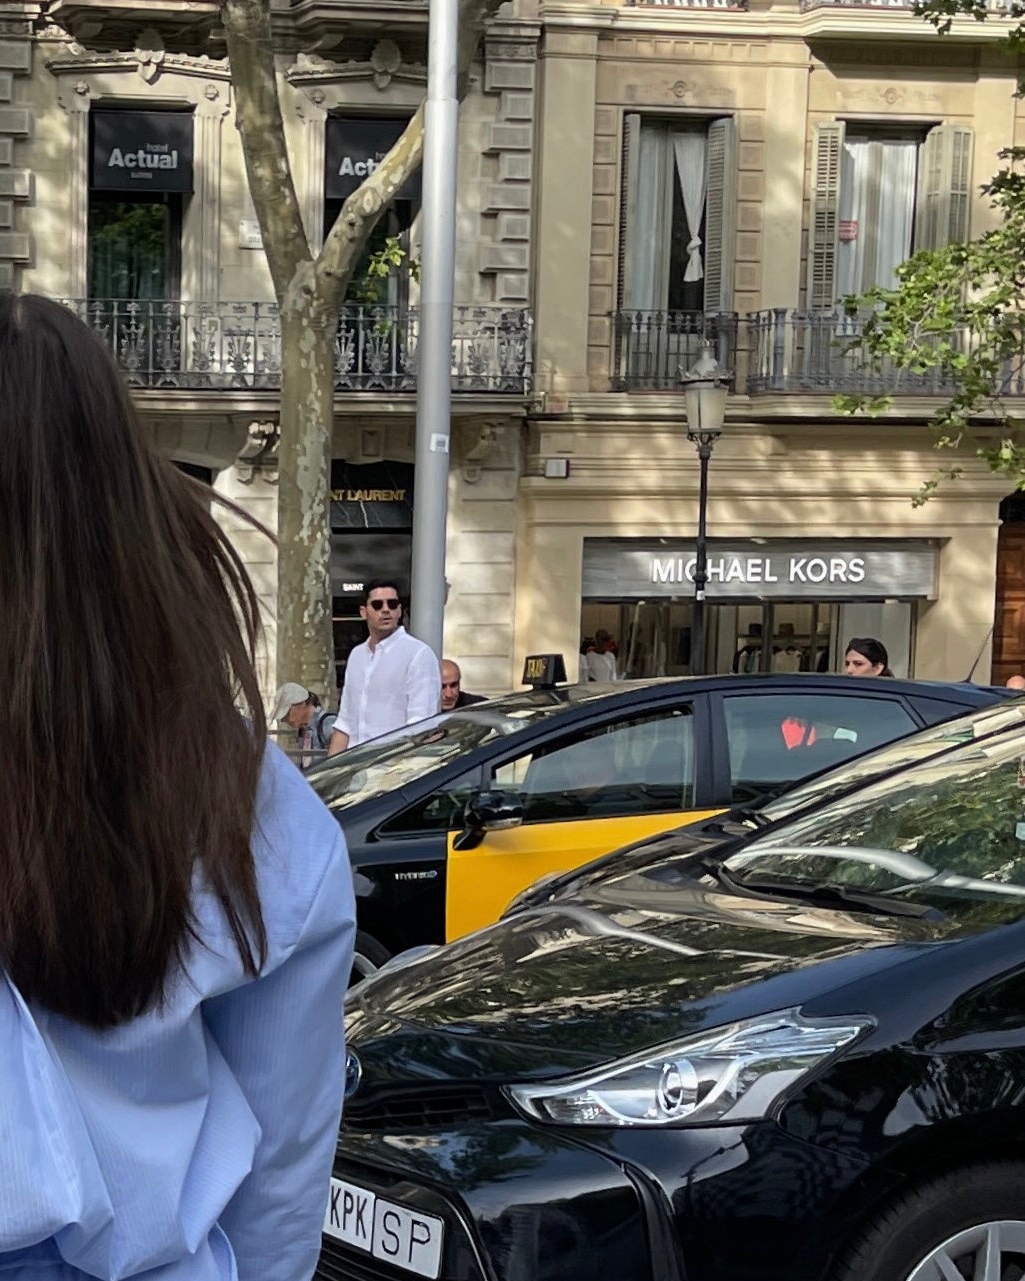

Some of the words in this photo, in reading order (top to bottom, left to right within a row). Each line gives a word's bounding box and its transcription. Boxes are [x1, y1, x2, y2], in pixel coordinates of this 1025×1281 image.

[108, 147, 178, 169] Actual
[338, 156, 380, 177] Act
[347, 489, 406, 501] LAURENT
[789, 558, 865, 582] KORS
[382, 1210, 430, 1263] SP
